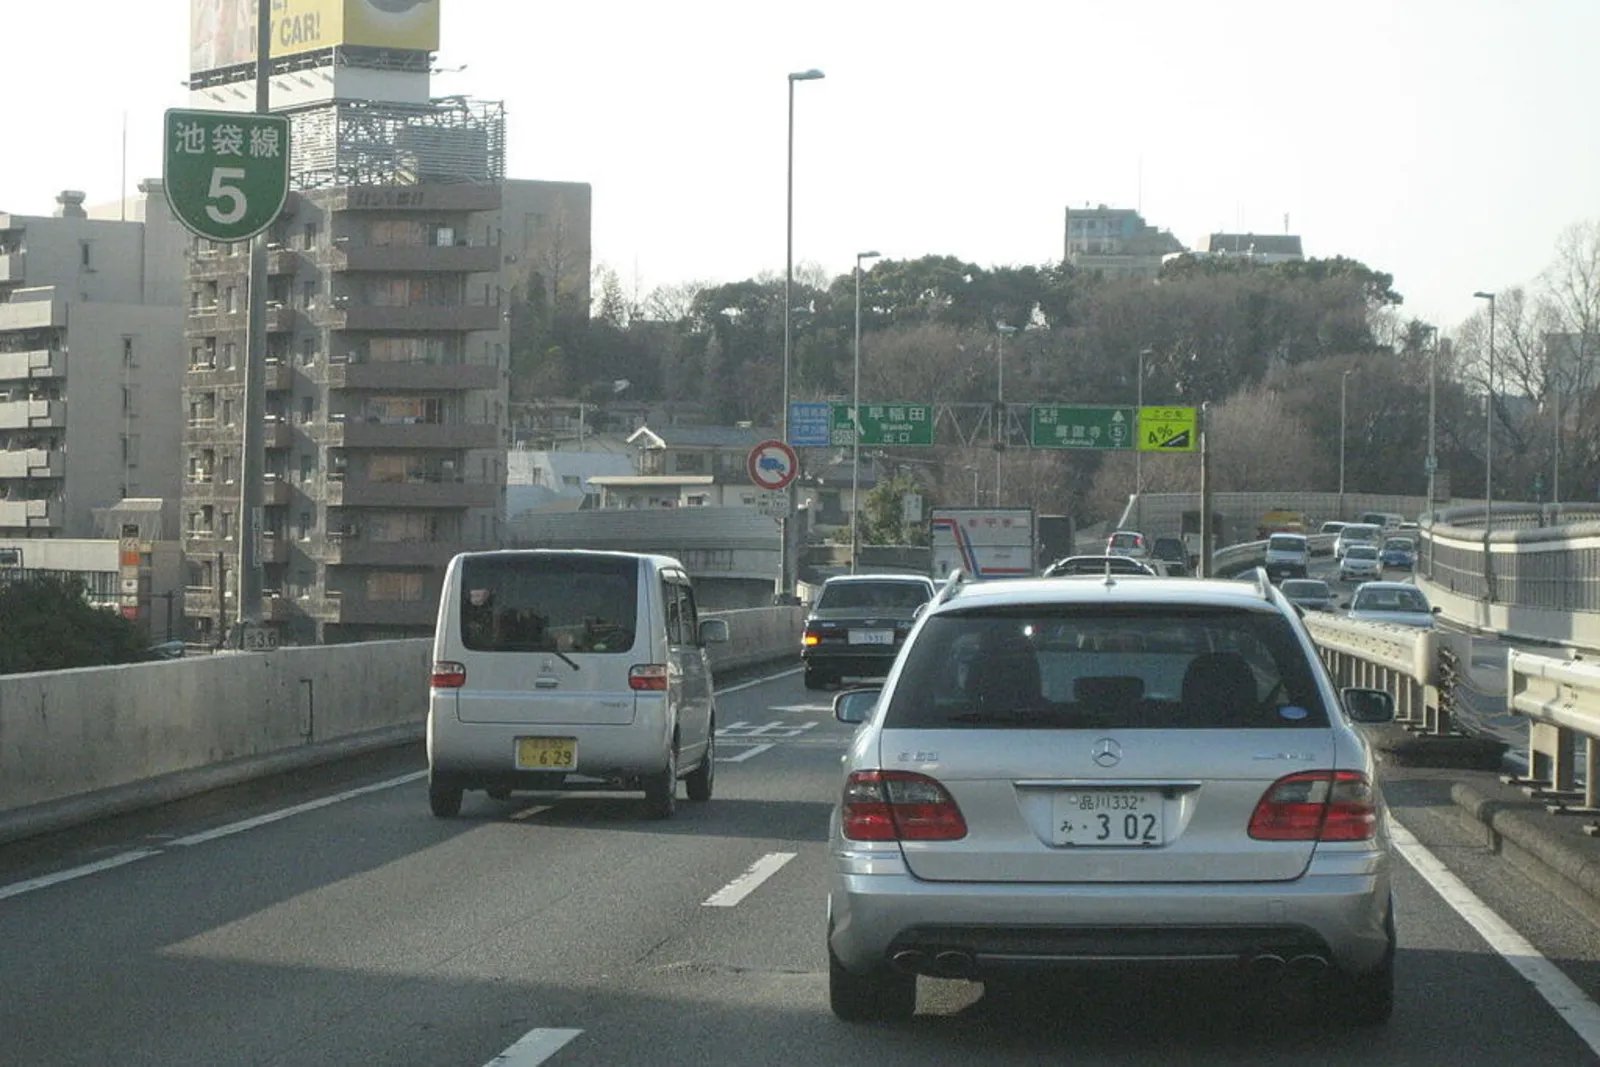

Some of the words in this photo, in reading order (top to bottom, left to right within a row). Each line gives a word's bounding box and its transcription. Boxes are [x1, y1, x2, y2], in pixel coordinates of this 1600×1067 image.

[280, 12, 321, 46] CAR!
[175, 121, 280, 158] 池袋線
[205, 167, 248, 224] 5
